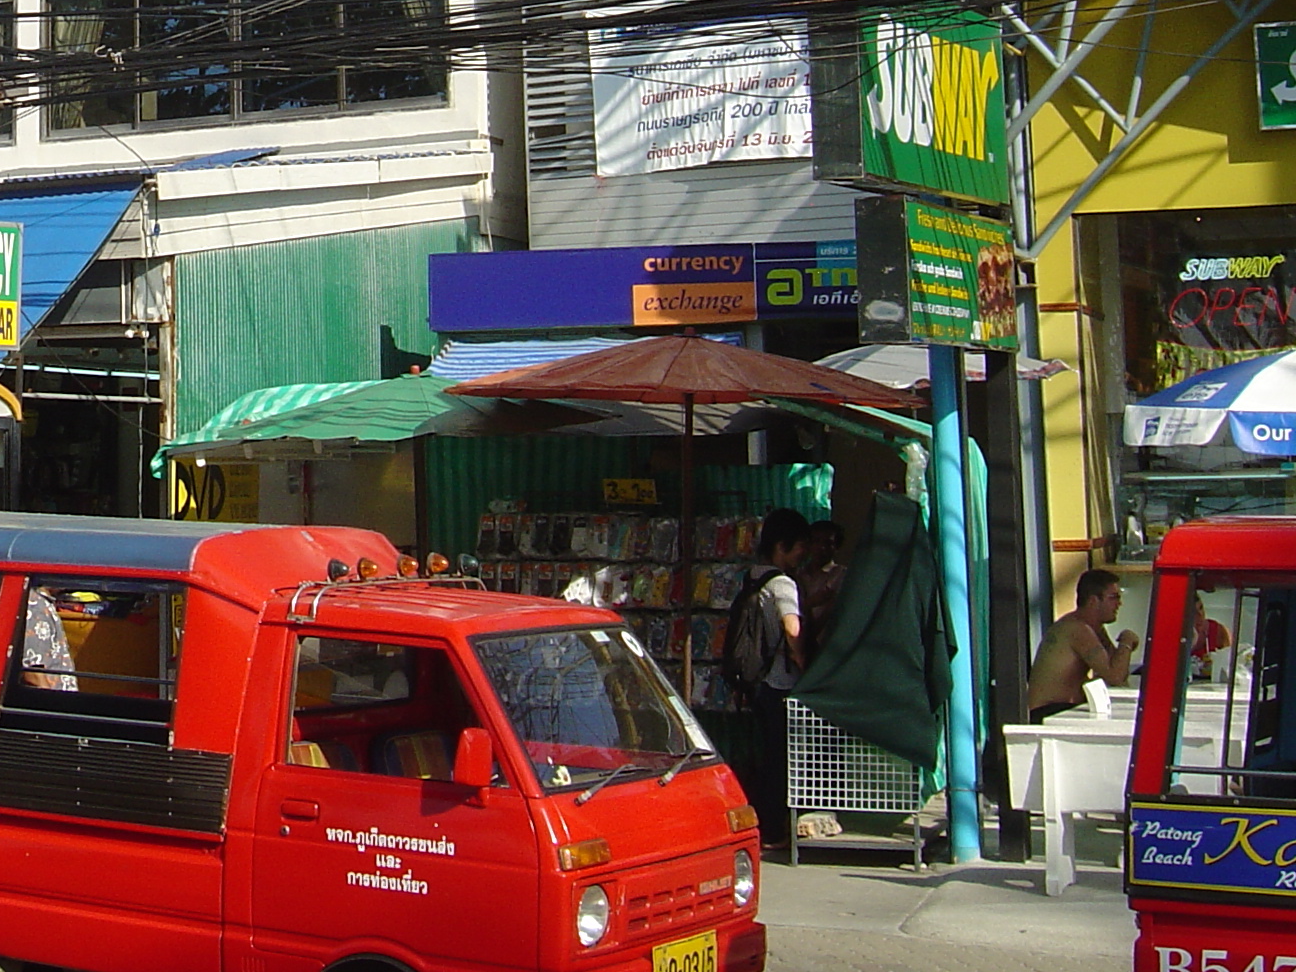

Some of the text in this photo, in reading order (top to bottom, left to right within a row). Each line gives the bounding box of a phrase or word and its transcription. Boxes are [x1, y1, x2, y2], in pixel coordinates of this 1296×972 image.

[867, 13, 999, 161] SUBWAY
[730, 101, 763, 119] 200
[741, 132, 762, 147] 13
[642, 253, 745, 276] currency
[1179, 254, 1286, 282] SUBWAY
[642, 288, 744, 315] exchange
[1169, 286, 1296, 329] OPEN
[1252, 422, 1293, 442] Our
[175, 461, 226, 520] DVD
[1141, 820, 1204, 849] Patong
[375, 853, 402, 869] และ
[1141, 845, 1193, 866] Beach
[347, 869, 428, 895] การท่องเที่ยว
